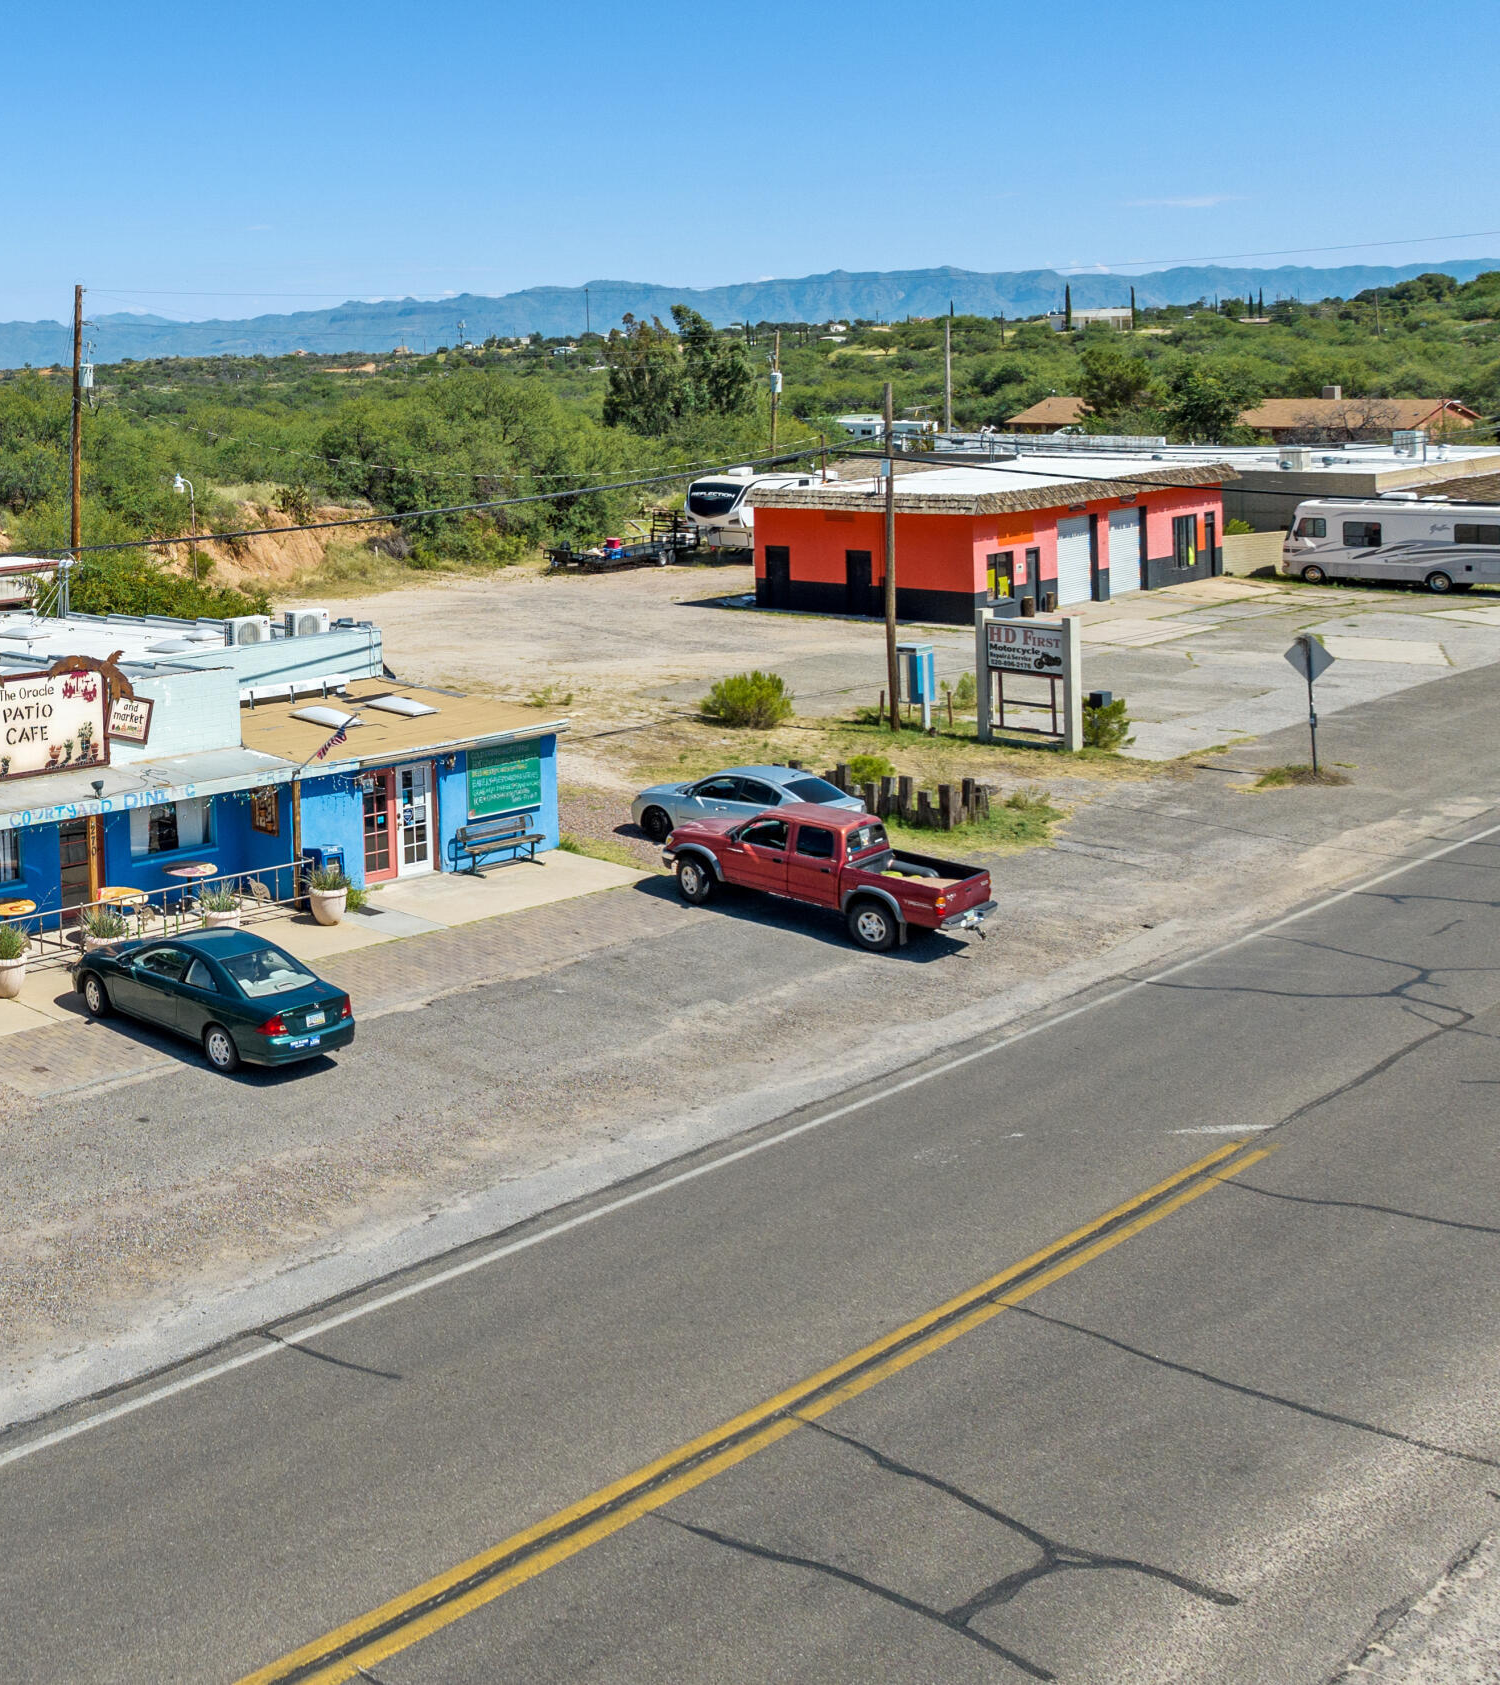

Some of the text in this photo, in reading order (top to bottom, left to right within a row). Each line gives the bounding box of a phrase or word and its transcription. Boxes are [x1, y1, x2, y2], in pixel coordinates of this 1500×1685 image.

[989, 627, 1016, 643] HD
[990, 643, 1041, 655] Motorcycle
[19, 683, 55, 700] Oracle
[123, 703, 139, 713] and
[113, 711, 145, 725] market
[6, 725, 49, 745] CAFE
[8, 799, 114, 829] COURTYARD
